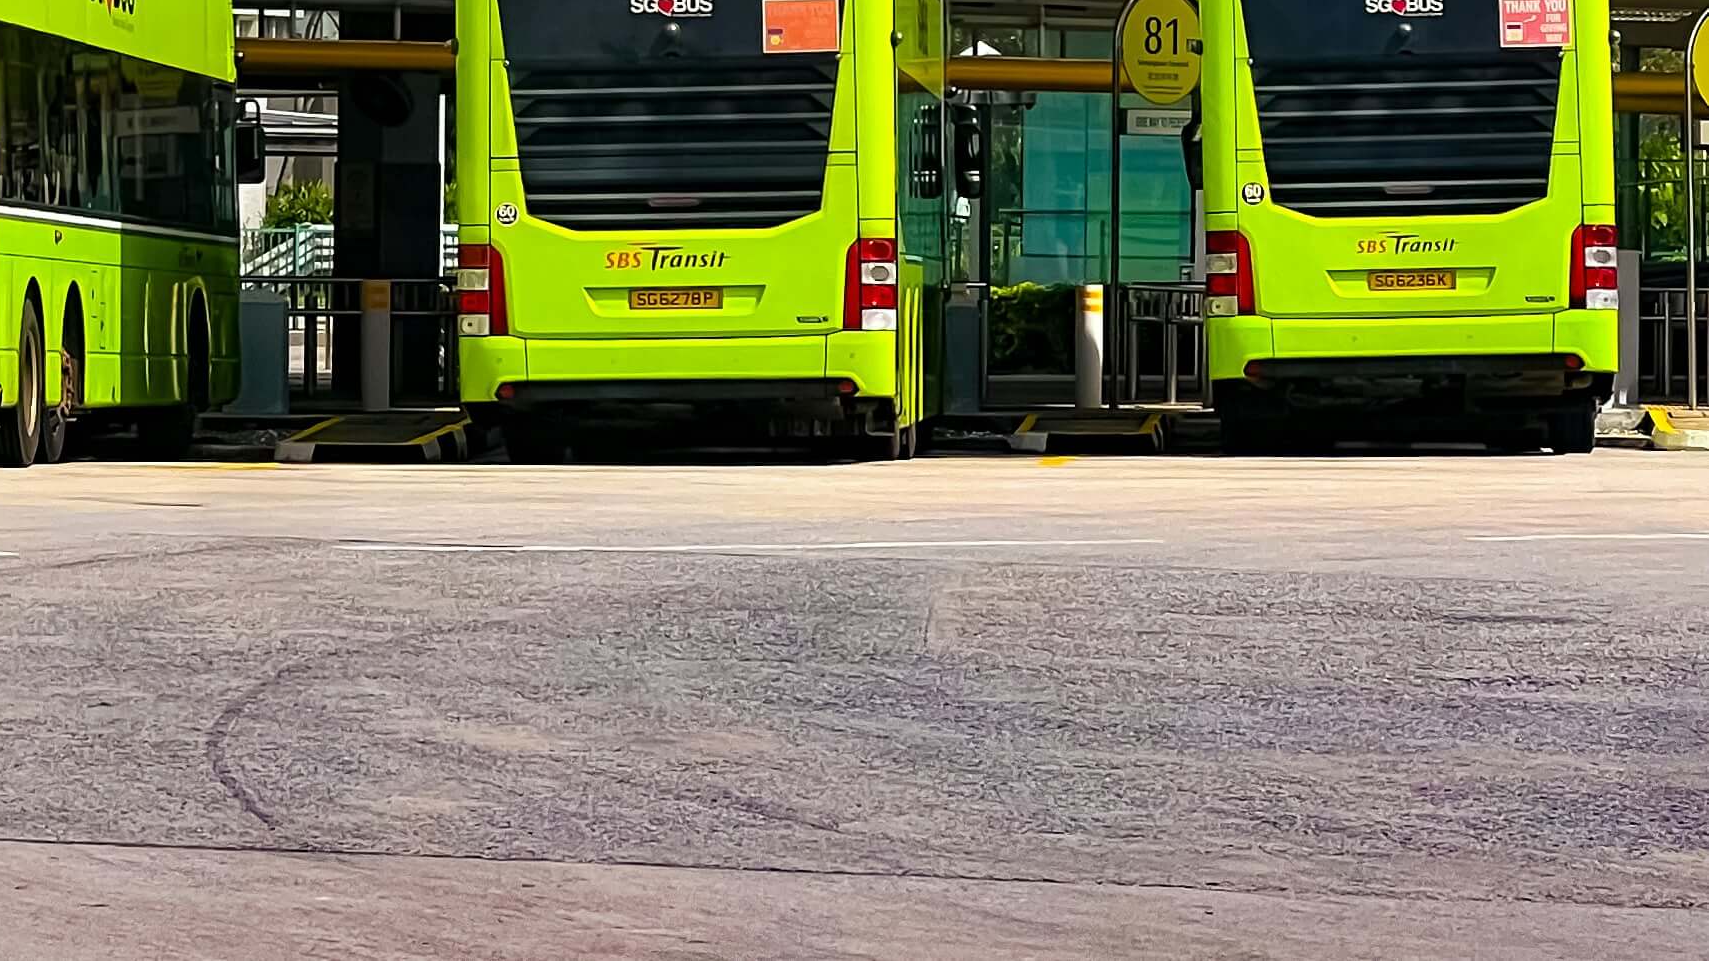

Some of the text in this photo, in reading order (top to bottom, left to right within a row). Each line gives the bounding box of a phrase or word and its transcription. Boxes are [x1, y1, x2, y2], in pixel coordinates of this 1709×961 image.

[1504, 0, 1566, 14] THANK YOU
[1145, 16, 1178, 55] 81
[1245, 184, 1261, 197] 60
[499, 206, 515, 217] 60
[1356, 234, 1459, 255] SBS Transit
[604, 246, 731, 271] SBS Transit
[1375, 274, 1447, 288] SG6236K
[637, 291, 714, 306] SG6278P
